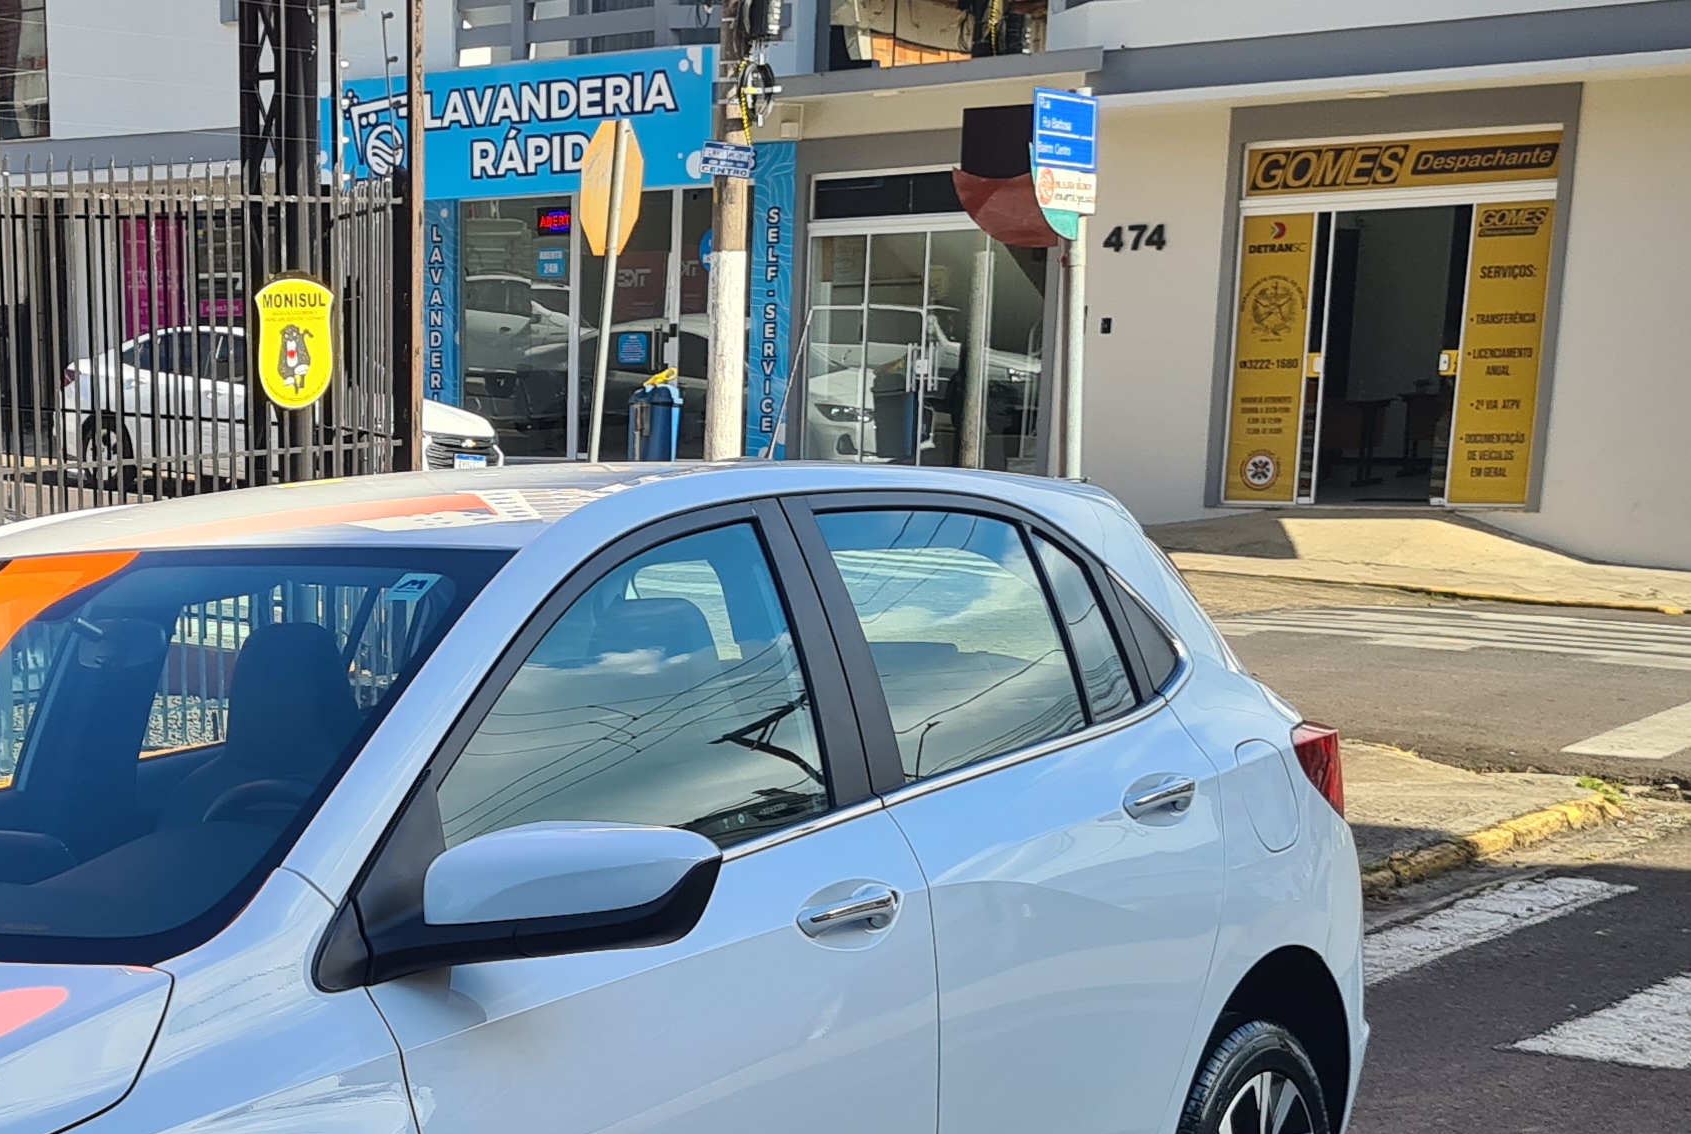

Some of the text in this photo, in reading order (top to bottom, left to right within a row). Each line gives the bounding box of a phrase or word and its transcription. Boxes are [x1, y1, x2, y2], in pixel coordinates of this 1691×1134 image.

[424, 71, 677, 130] LAVANDERIA
[471, 128, 590, 179] RÁPID
[1253, 145, 1552, 189] GOMES Despachante
[701, 165, 747, 177] CENTRO
[540, 214, 571, 228] ABERT
[1480, 207, 1548, 226] GOMES
[765, 207, 780, 282] SELF
[1103, 224, 1166, 252] 474
[1480, 264, 1537, 280] SERVIÇOS:
[262, 293, 326, 309] MONISUL
[760, 303, 777, 433] SERVICE
